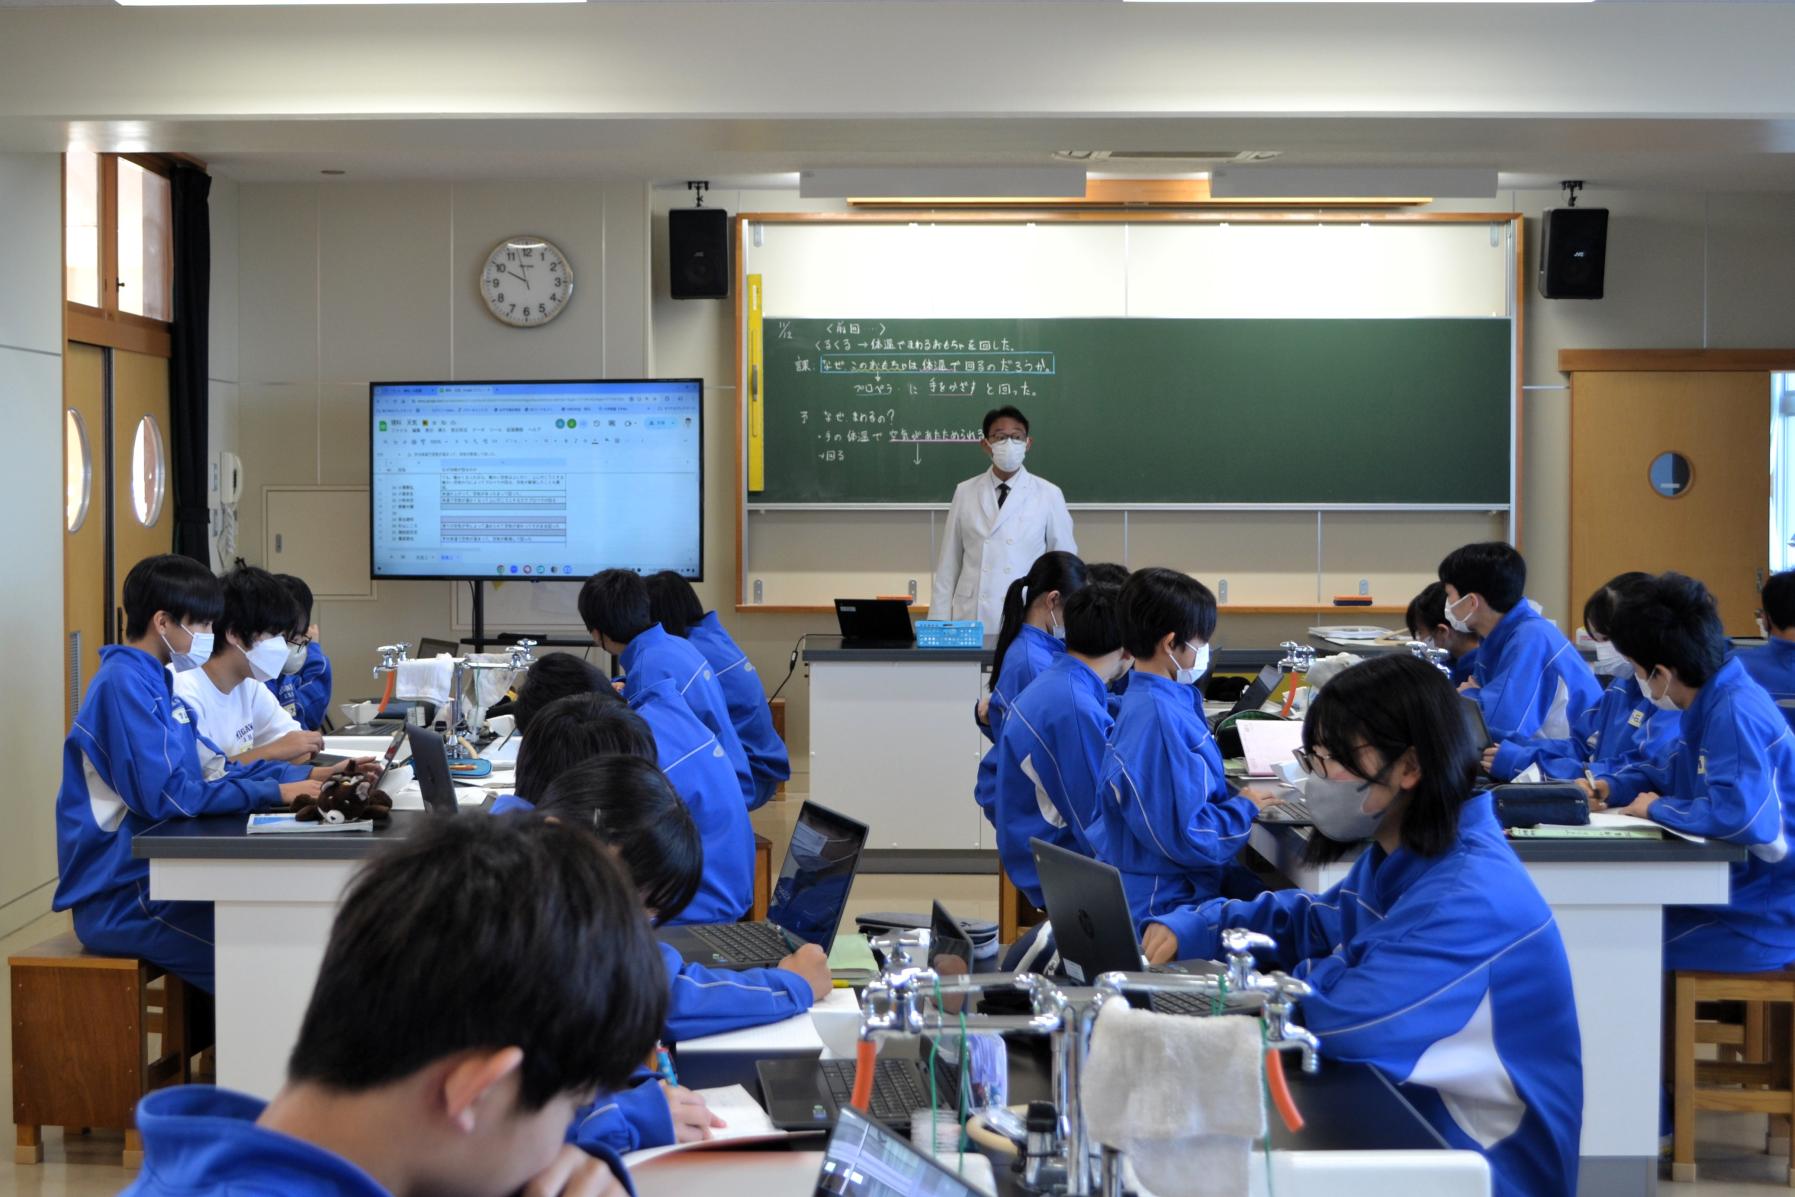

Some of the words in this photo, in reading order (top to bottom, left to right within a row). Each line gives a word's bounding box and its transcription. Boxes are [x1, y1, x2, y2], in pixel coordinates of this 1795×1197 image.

[507, 252, 515, 261] 11
[523, 248, 533, 257] 12
[496, 263, 506, 273] 10
